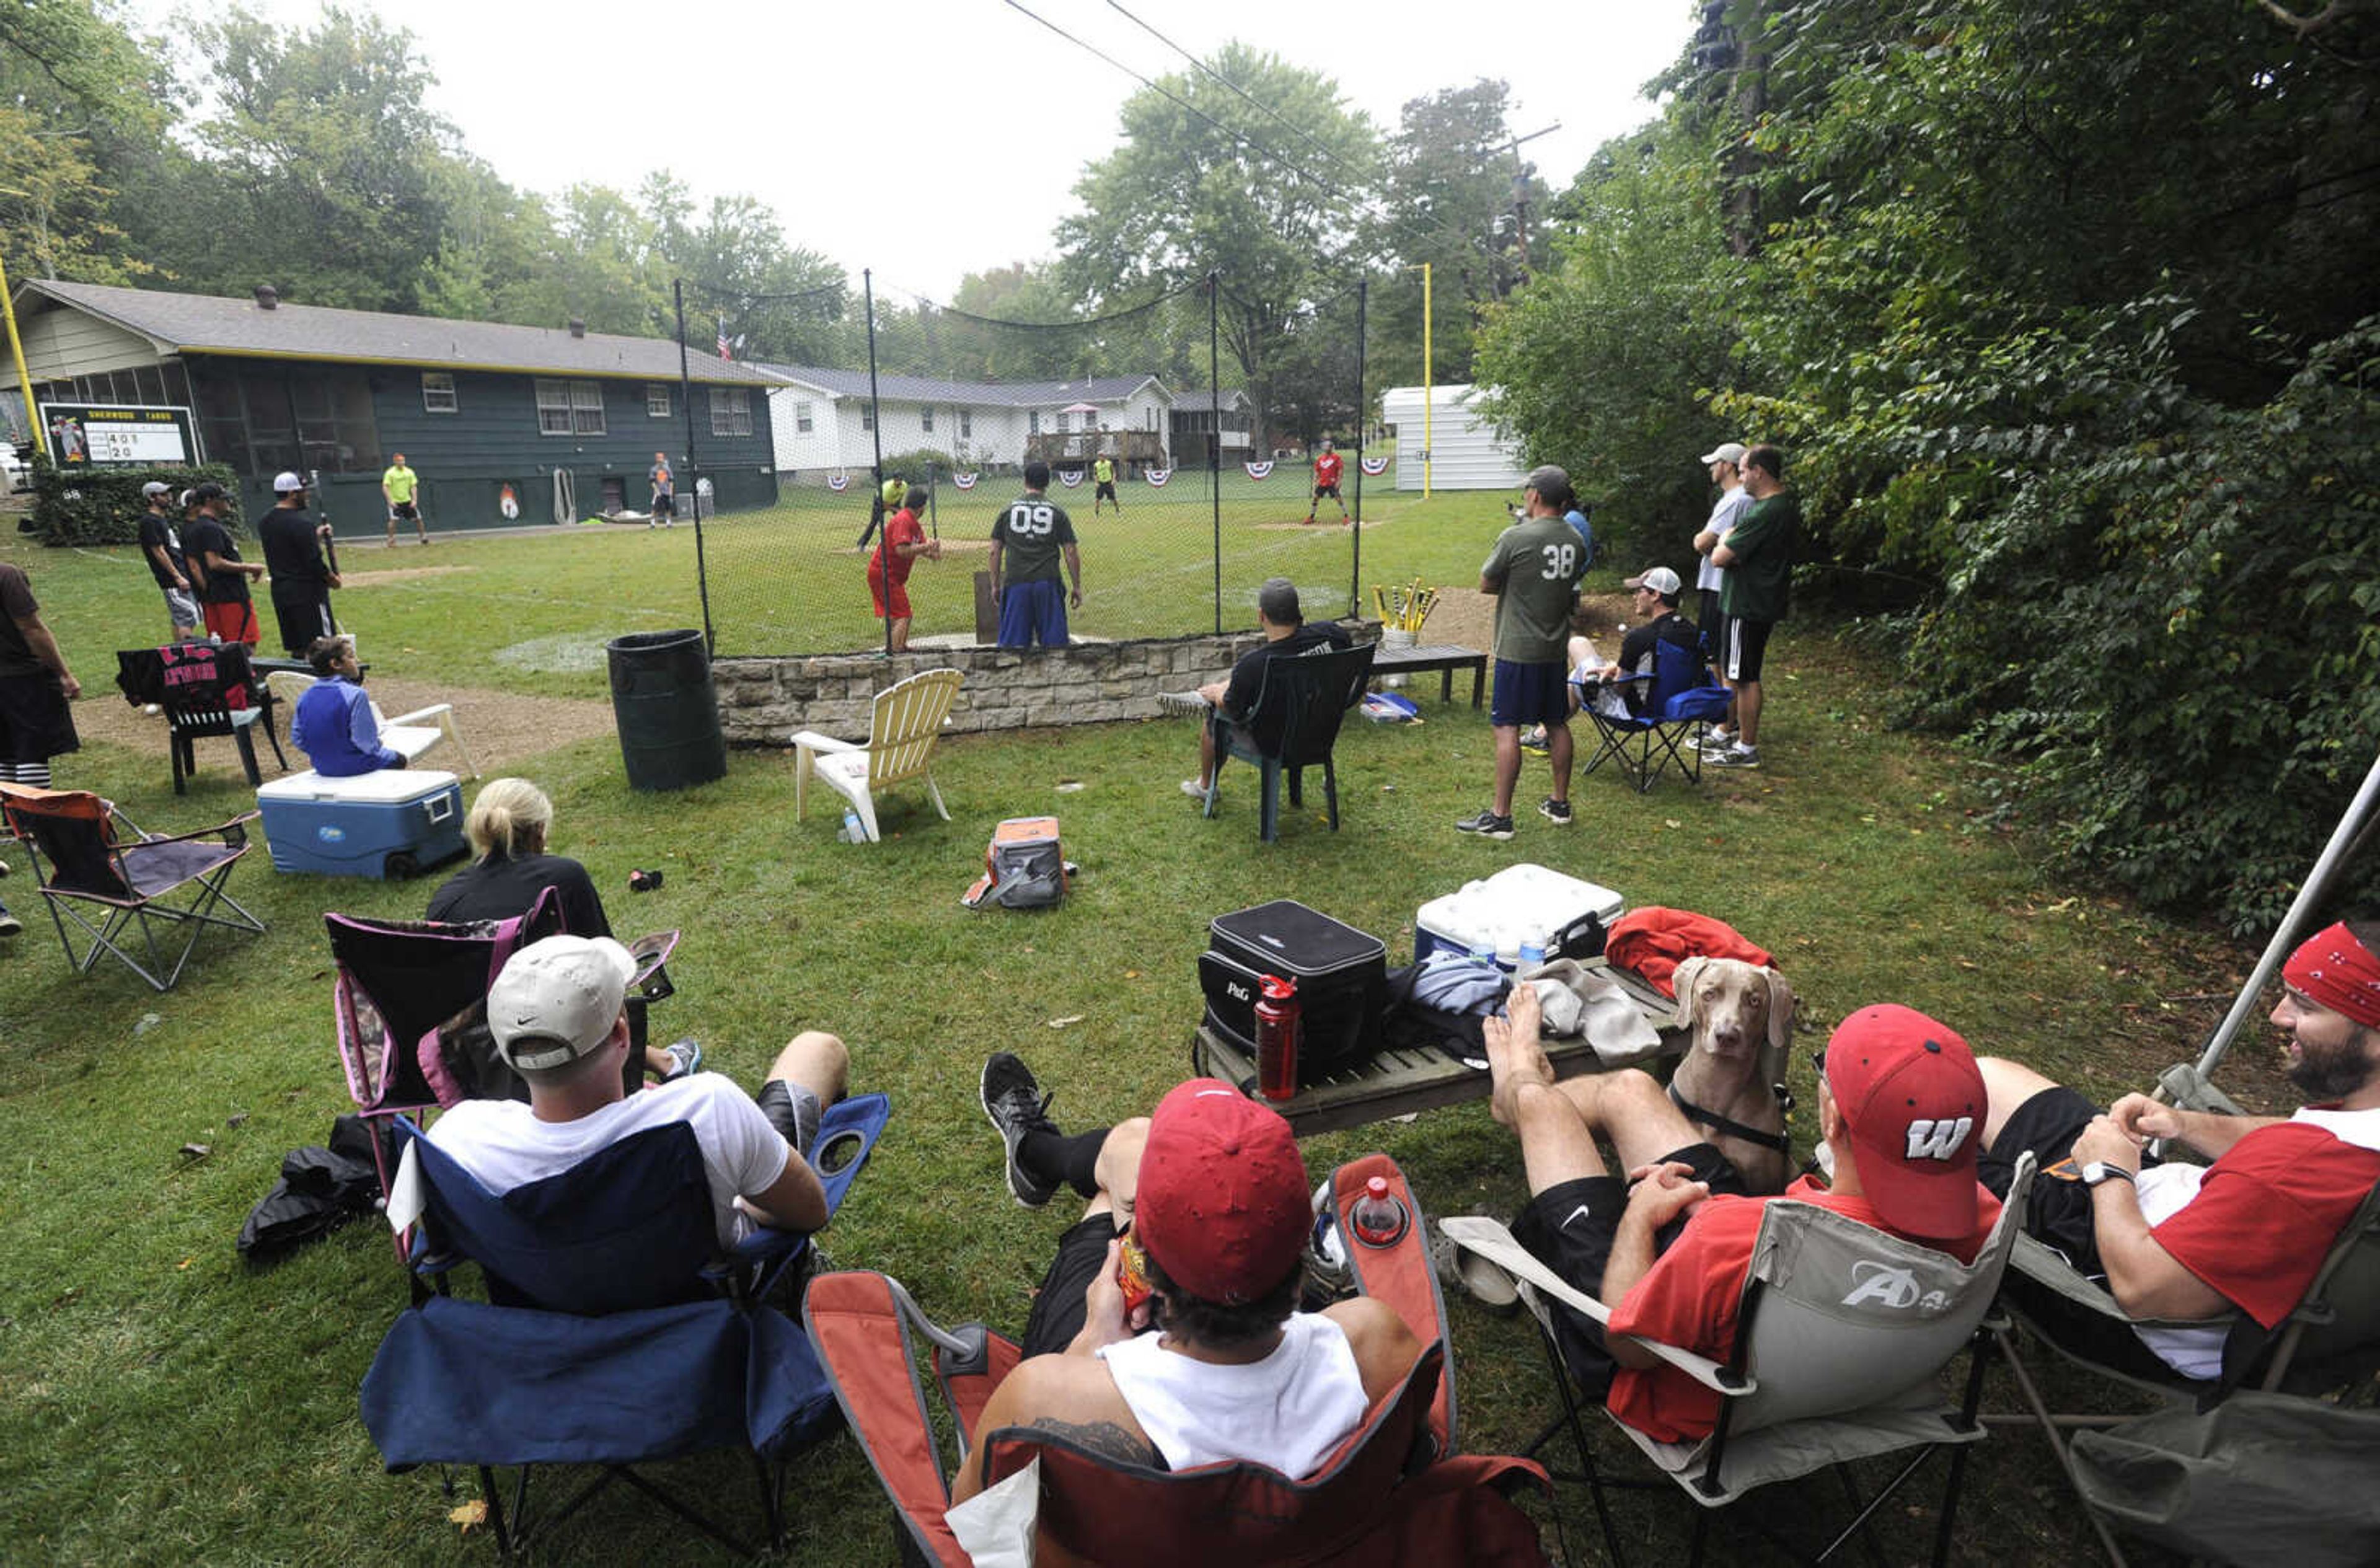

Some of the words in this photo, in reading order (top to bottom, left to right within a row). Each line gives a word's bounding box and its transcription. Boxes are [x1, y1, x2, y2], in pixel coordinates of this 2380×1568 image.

[1010, 505, 1054, 534] 09
[1541, 544, 1576, 580] 38
[1906, 1117, 1973, 1159] W
